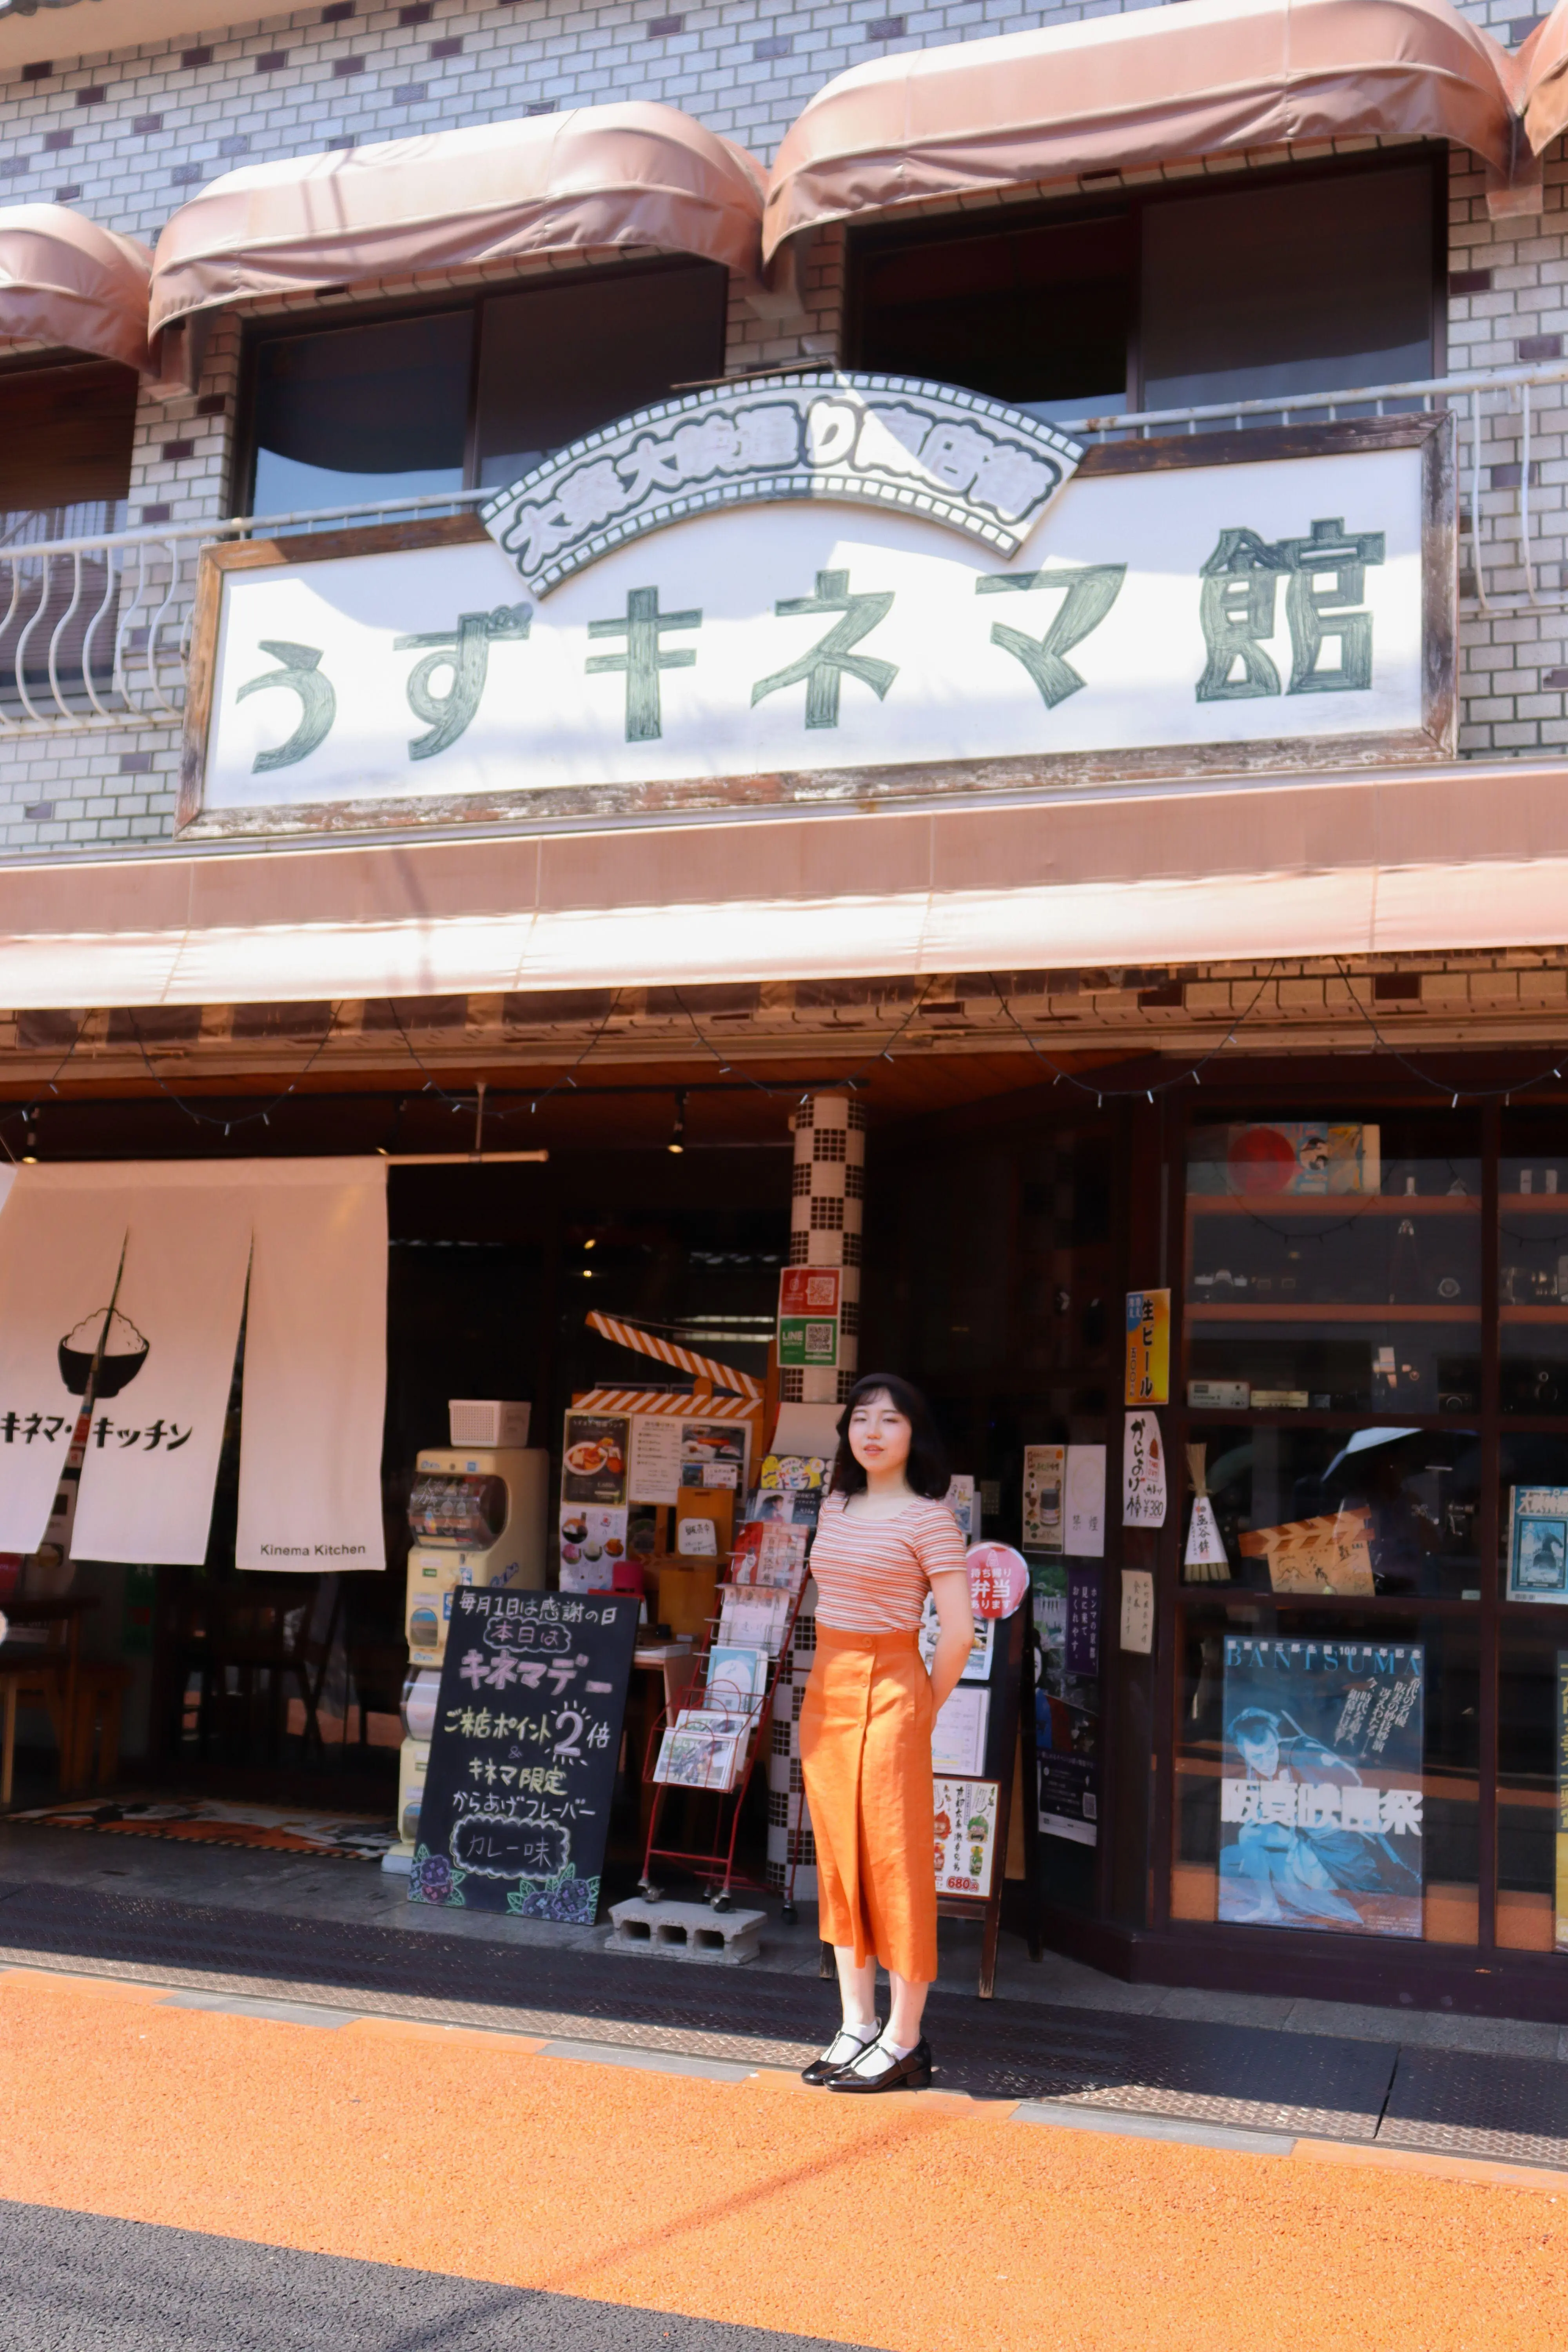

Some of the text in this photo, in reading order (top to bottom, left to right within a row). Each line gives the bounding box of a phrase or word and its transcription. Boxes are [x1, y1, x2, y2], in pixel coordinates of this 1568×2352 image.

[236, 517, 1386, 774] うずキネマ館
[782, 1331, 803, 1341] LINE
[1140, 1298, 1154, 1399] 生ビール
[1143, 1499, 1164, 1518] ¥380
[260, 1543, 365, 1557] Kinema Kitchen
[971, 1567, 1011, 1578] 持ち帰り
[971, 1579, 1011, 1598] 弁当
[459, 1592, 618, 1625] 毎月1日は感謝の日
[971, 1599, 1011, 1610] あります
[1081, 1585, 1089, 1636] 見に来て
[491, 1621, 558, 1646] 本日は
[459, 1649, 613, 1695] キネマデー
[1225, 1645, 1421, 1676] BANTSUMA
[508, 1746, 523, 1759] &
[469, 1758, 568, 1795] キネマ限定
[453, 1791, 596, 1819] からあげフレーバー
[466, 1835, 551, 1867] カレー味
[947, 1876, 980, 1892] 680円
